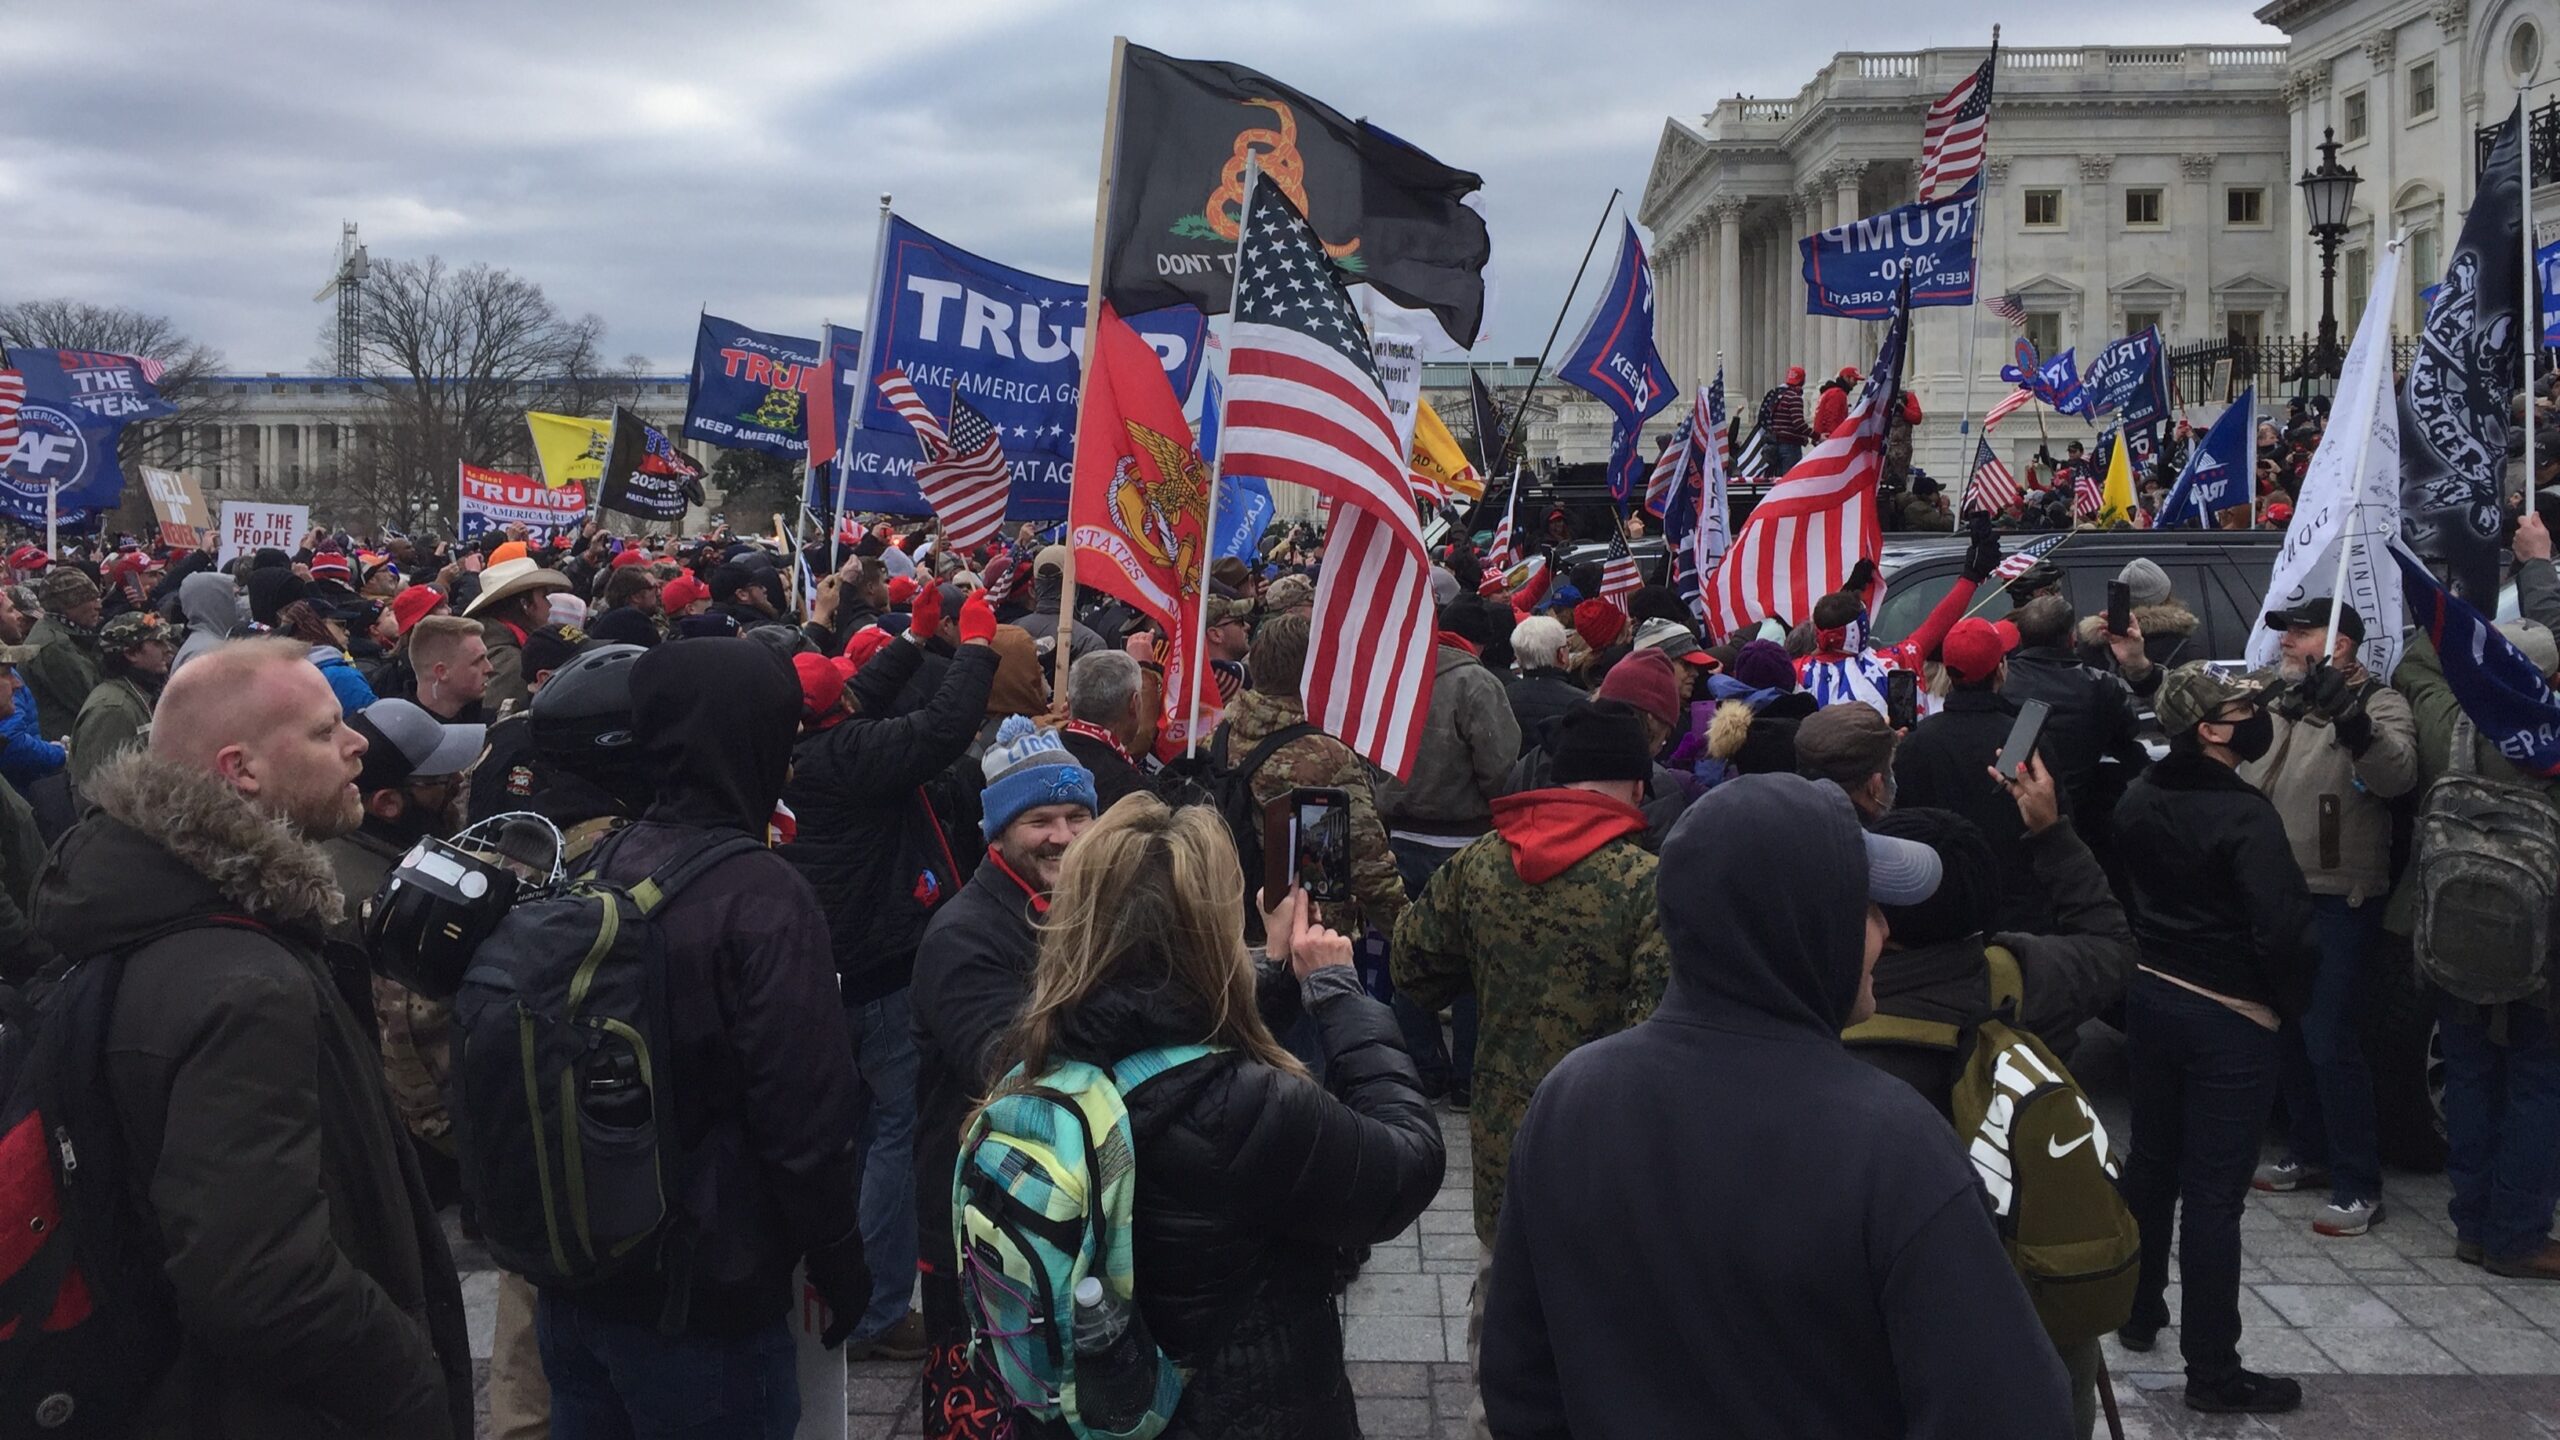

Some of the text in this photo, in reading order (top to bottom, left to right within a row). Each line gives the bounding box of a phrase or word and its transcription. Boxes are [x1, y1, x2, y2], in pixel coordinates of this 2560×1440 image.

[1157, 252, 1212, 276] DONT
[907, 274, 1188, 373] TRUP
[72, 370, 134, 393] THE
[720, 347, 818, 394] TRU
[896, 359, 957, 389] MAKE
[956, 369, 1050, 404] AMERICA
[72, 397, 149, 416] TEAL
[695, 416, 733, 435] KEEP
[13, 479, 48, 492] FIRST
[145, 470, 191, 505] HELL
[466, 477, 582, 508] TRUMP
[234, 512, 293, 530] WE THE
[490, 506, 543, 521] AMERICA
[233, 528, 292, 547] PEOPLE
[1074, 530, 1144, 582] STATES
[2351, 543, 2378, 625] MINUTE
